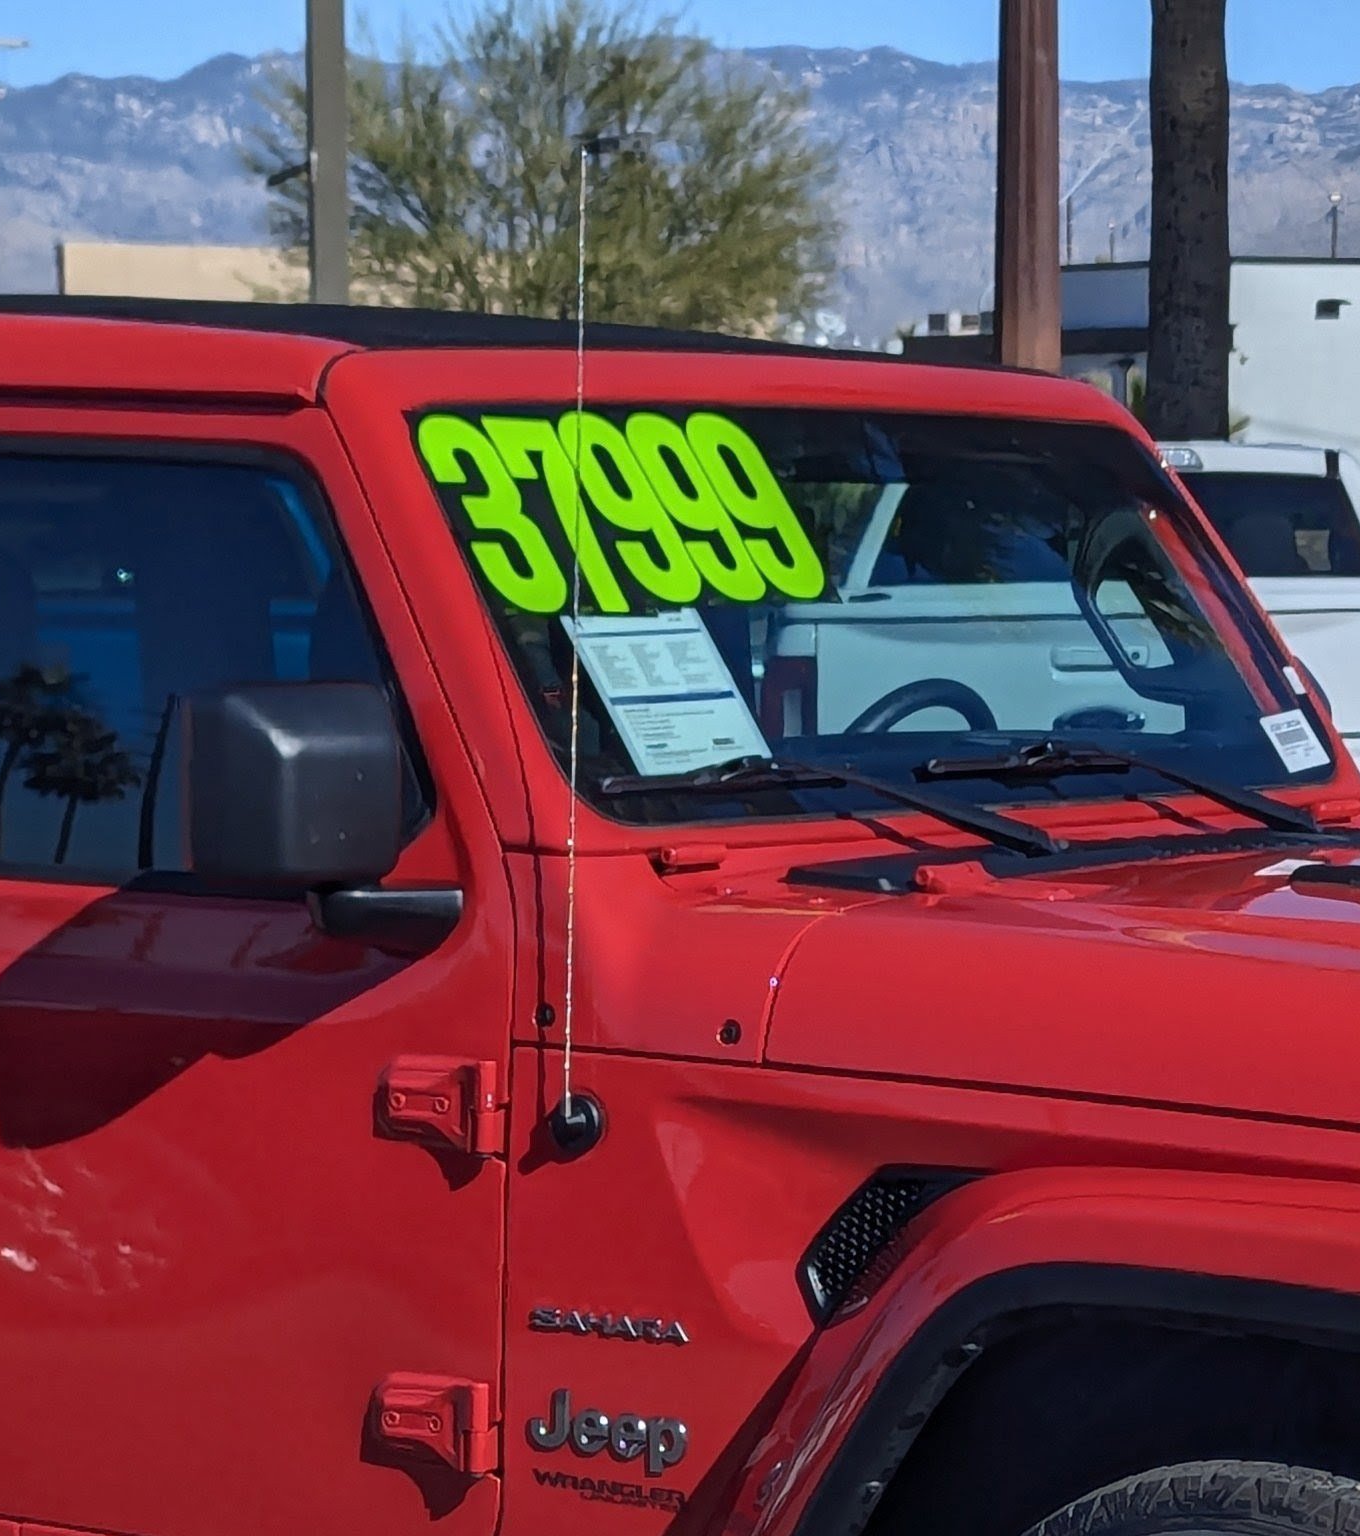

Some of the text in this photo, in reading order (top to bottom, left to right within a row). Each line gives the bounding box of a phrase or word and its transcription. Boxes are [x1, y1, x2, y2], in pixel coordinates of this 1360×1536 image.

[417, 410, 826, 614] 37999
[528, 1305, 690, 1347] SAHARA
[525, 1387, 688, 1478] Jeep
[532, 1468, 689, 1506] WRANGLER
